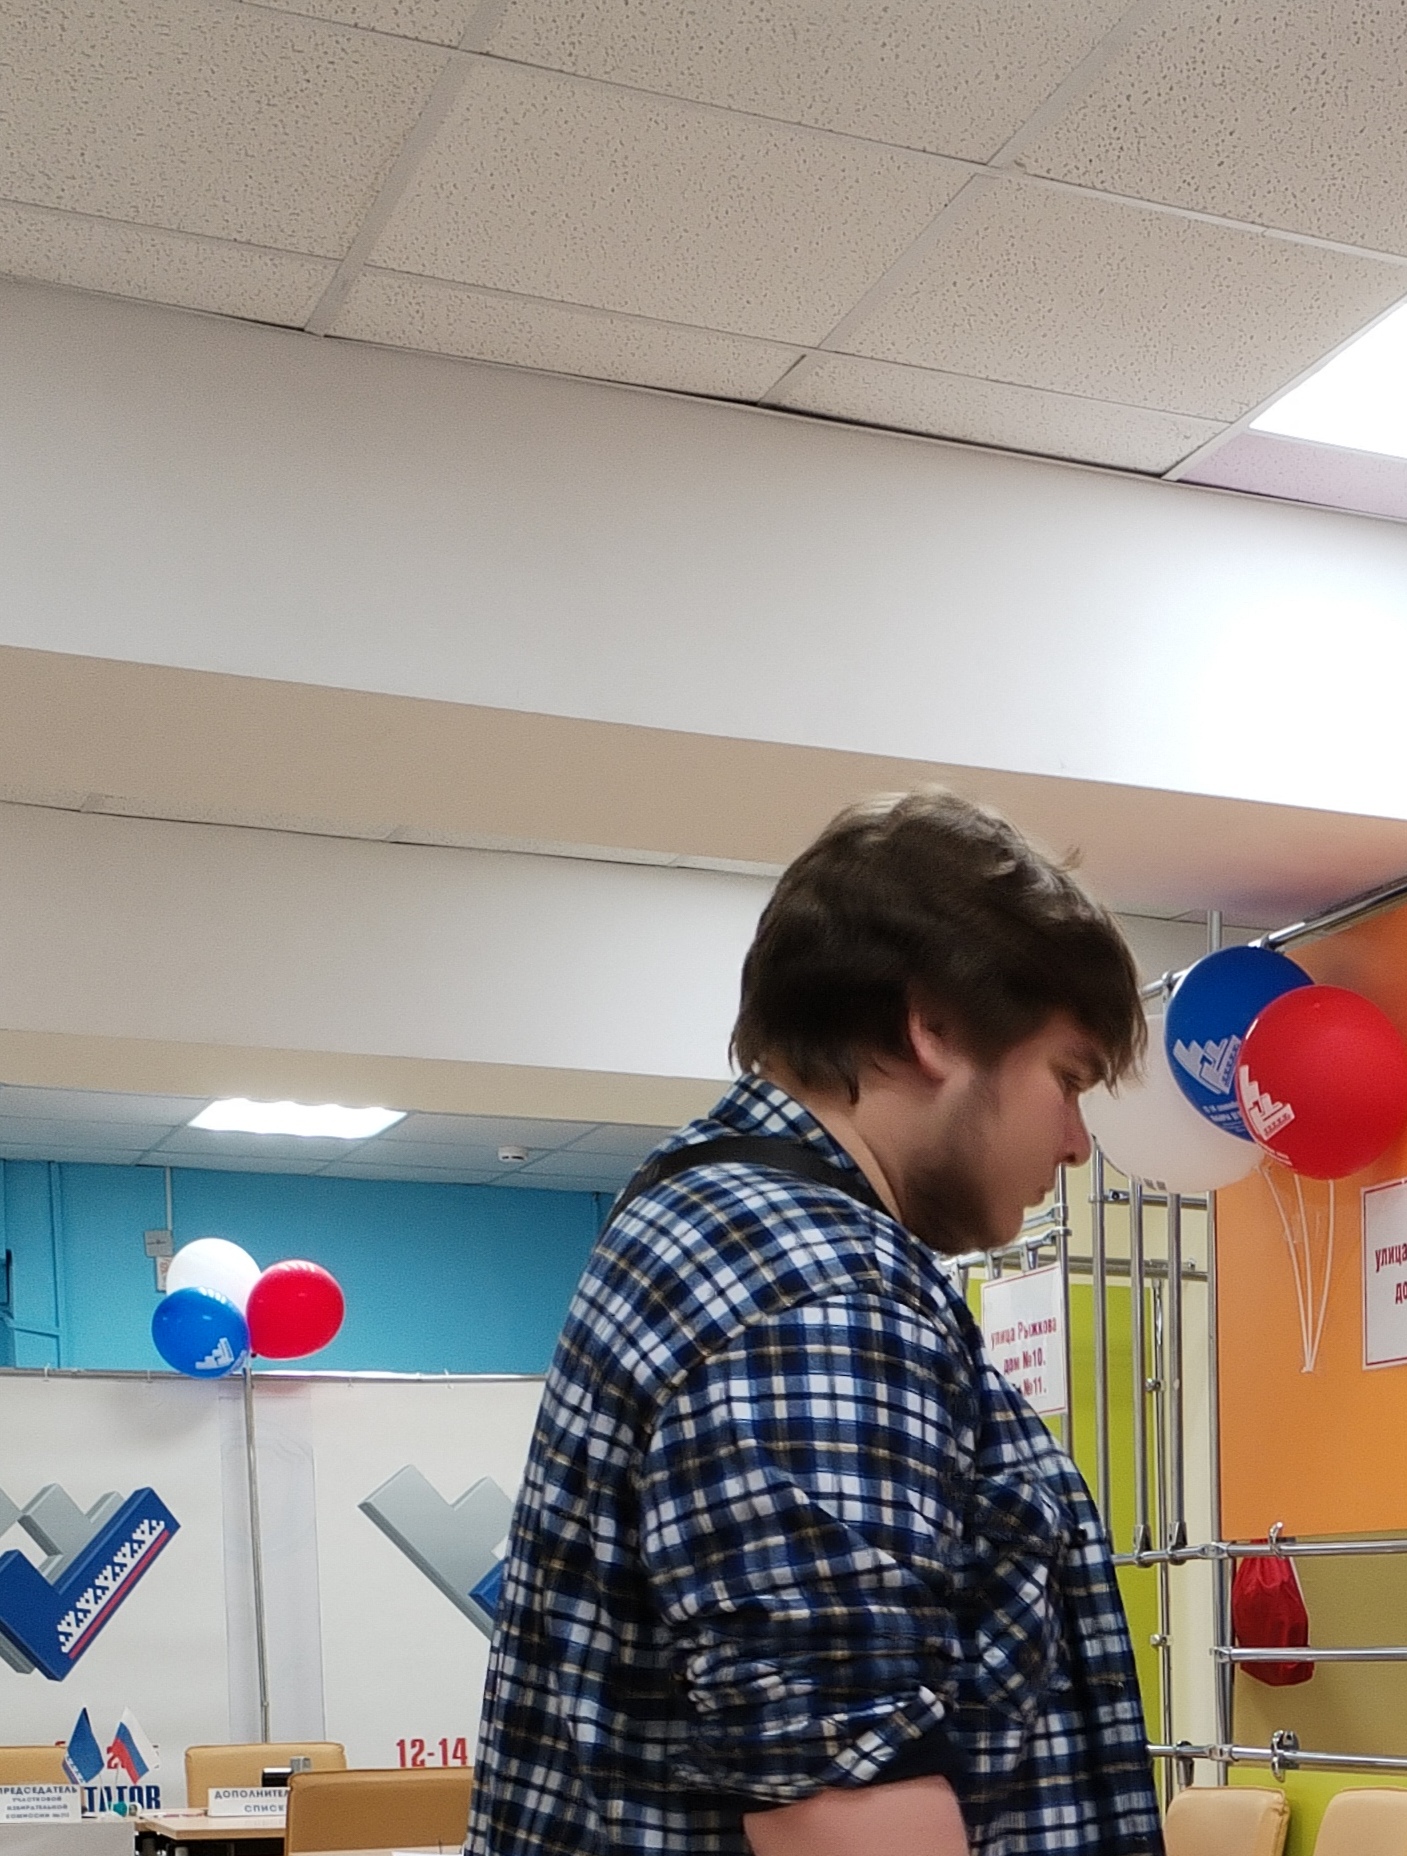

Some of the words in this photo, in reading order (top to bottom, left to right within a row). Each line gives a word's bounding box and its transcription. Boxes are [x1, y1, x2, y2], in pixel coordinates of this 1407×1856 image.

[1375, 1241, 1407, 1273] улица
[990, 1328, 1015, 1350] улица
[1018, 1317, 1057, 1341] Рыжкова
[1004, 1357, 1020, 1374] дом
[396, 1737, 468, 1768] 12-14
[215, 1789, 289, 1799] ДОПОЛНИТЕЛ
[244, 1804, 284, 1813] СПИСК
